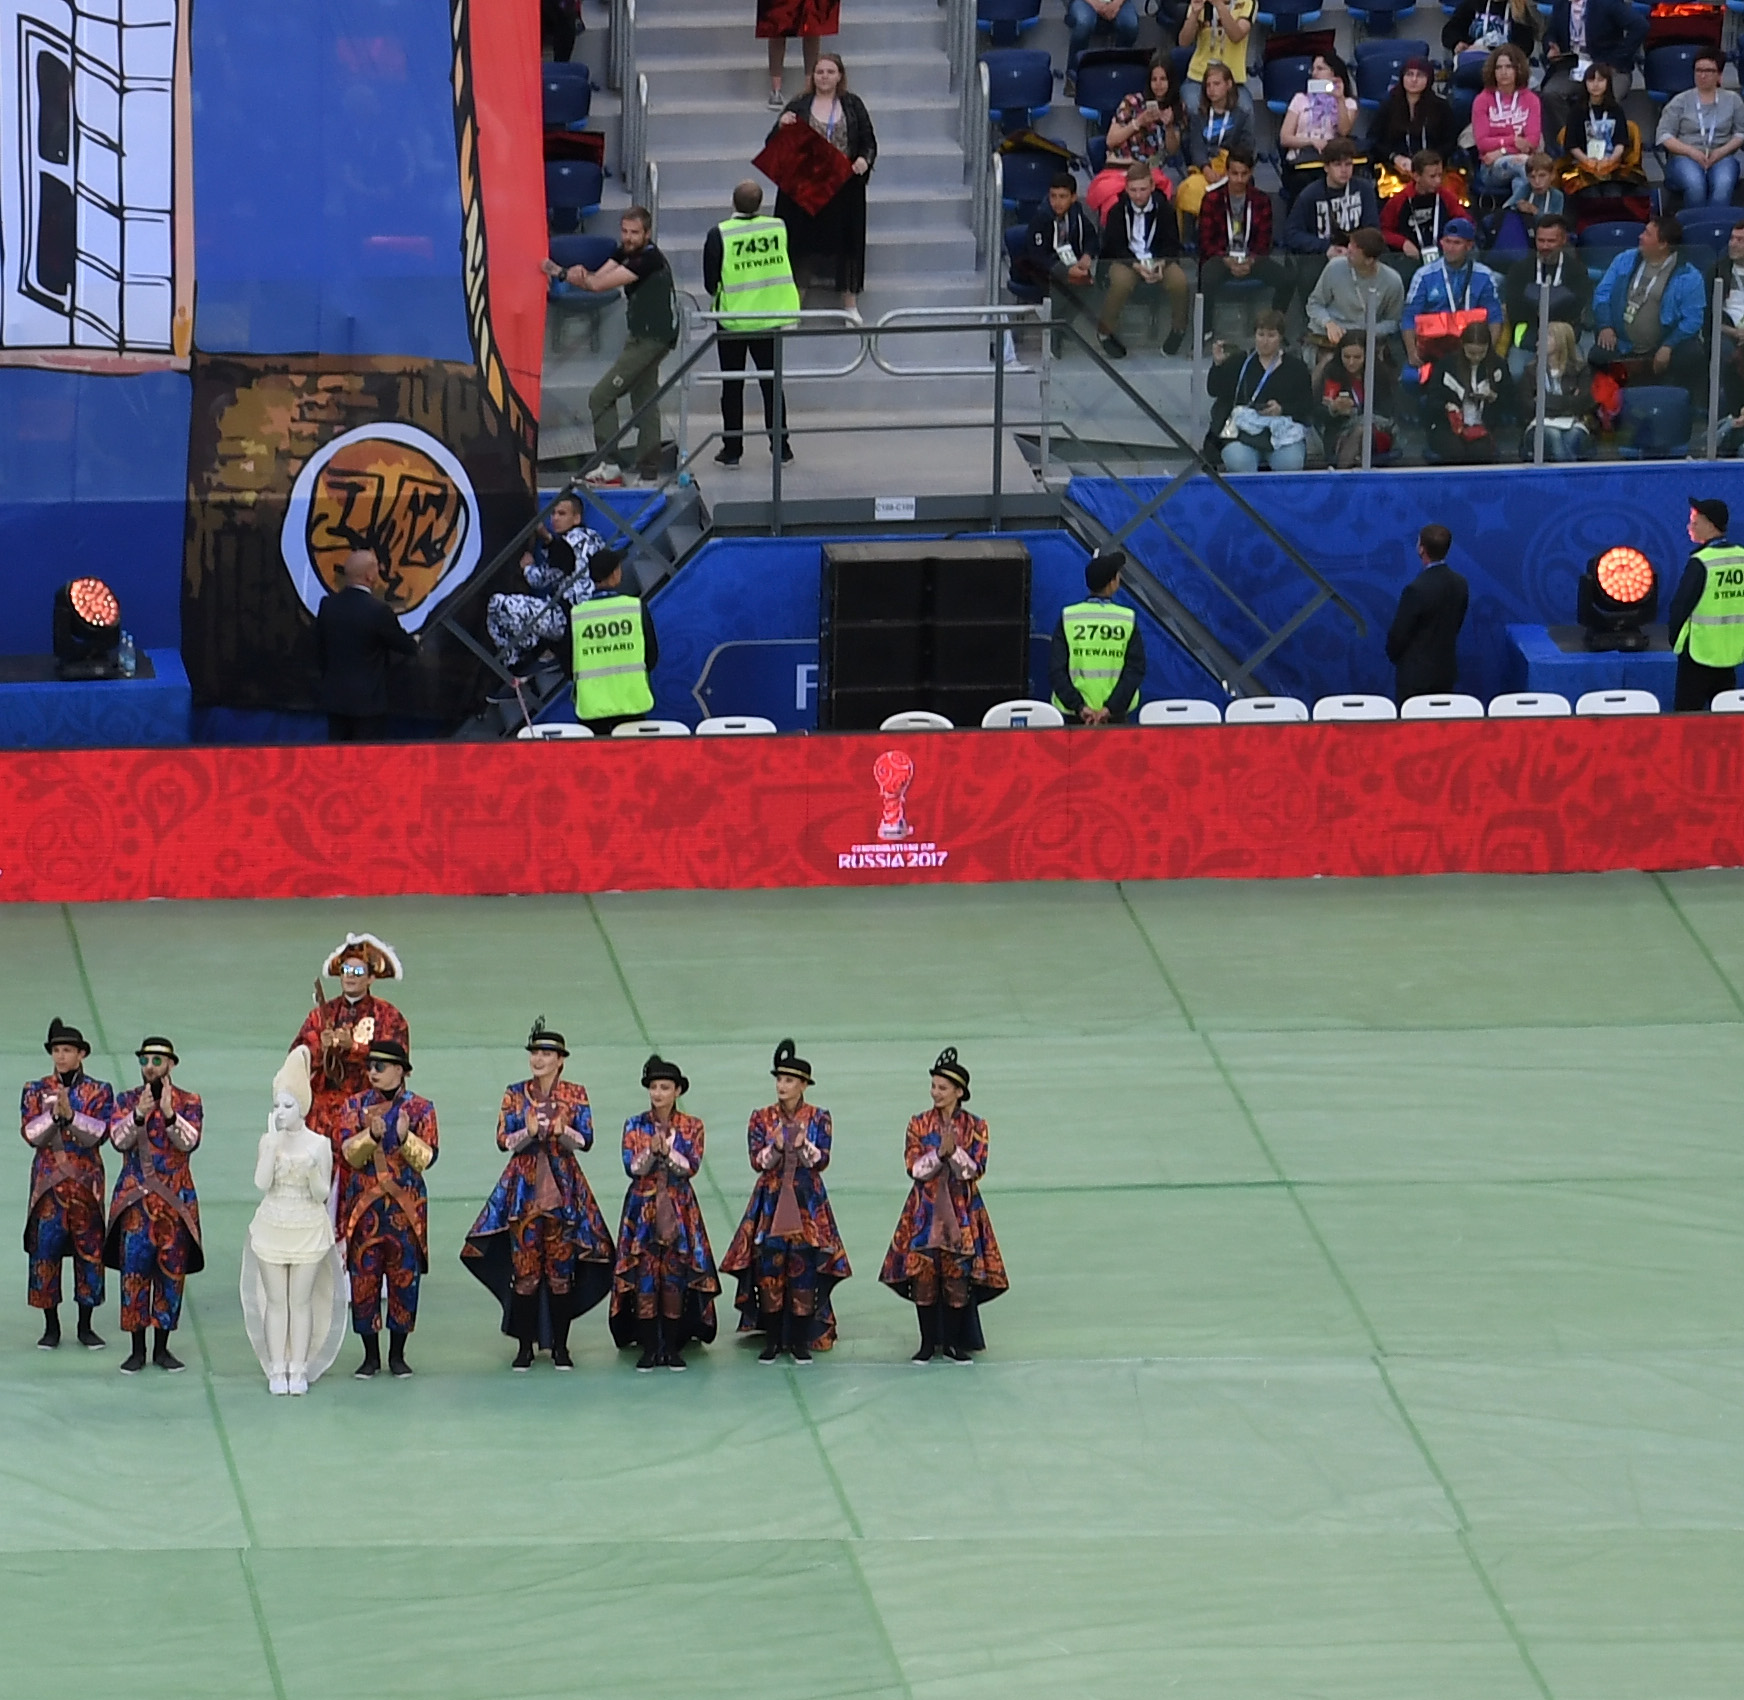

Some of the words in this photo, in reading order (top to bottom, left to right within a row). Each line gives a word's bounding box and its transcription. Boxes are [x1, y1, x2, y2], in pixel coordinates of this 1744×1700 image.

[733, 235, 779, 257] 7431
[734, 255, 784, 271] STEWARD
[1714, 590, 1744, 600] STEWA
[581, 619, 633, 640] 4909
[1073, 624, 1126, 641] 2799
[582, 642, 635, 657] STEWARD
[1073, 647, 1124, 658] STEWARD
[838, 852, 905, 869] RUSSIA
[906, 850, 948, 868] 2017
